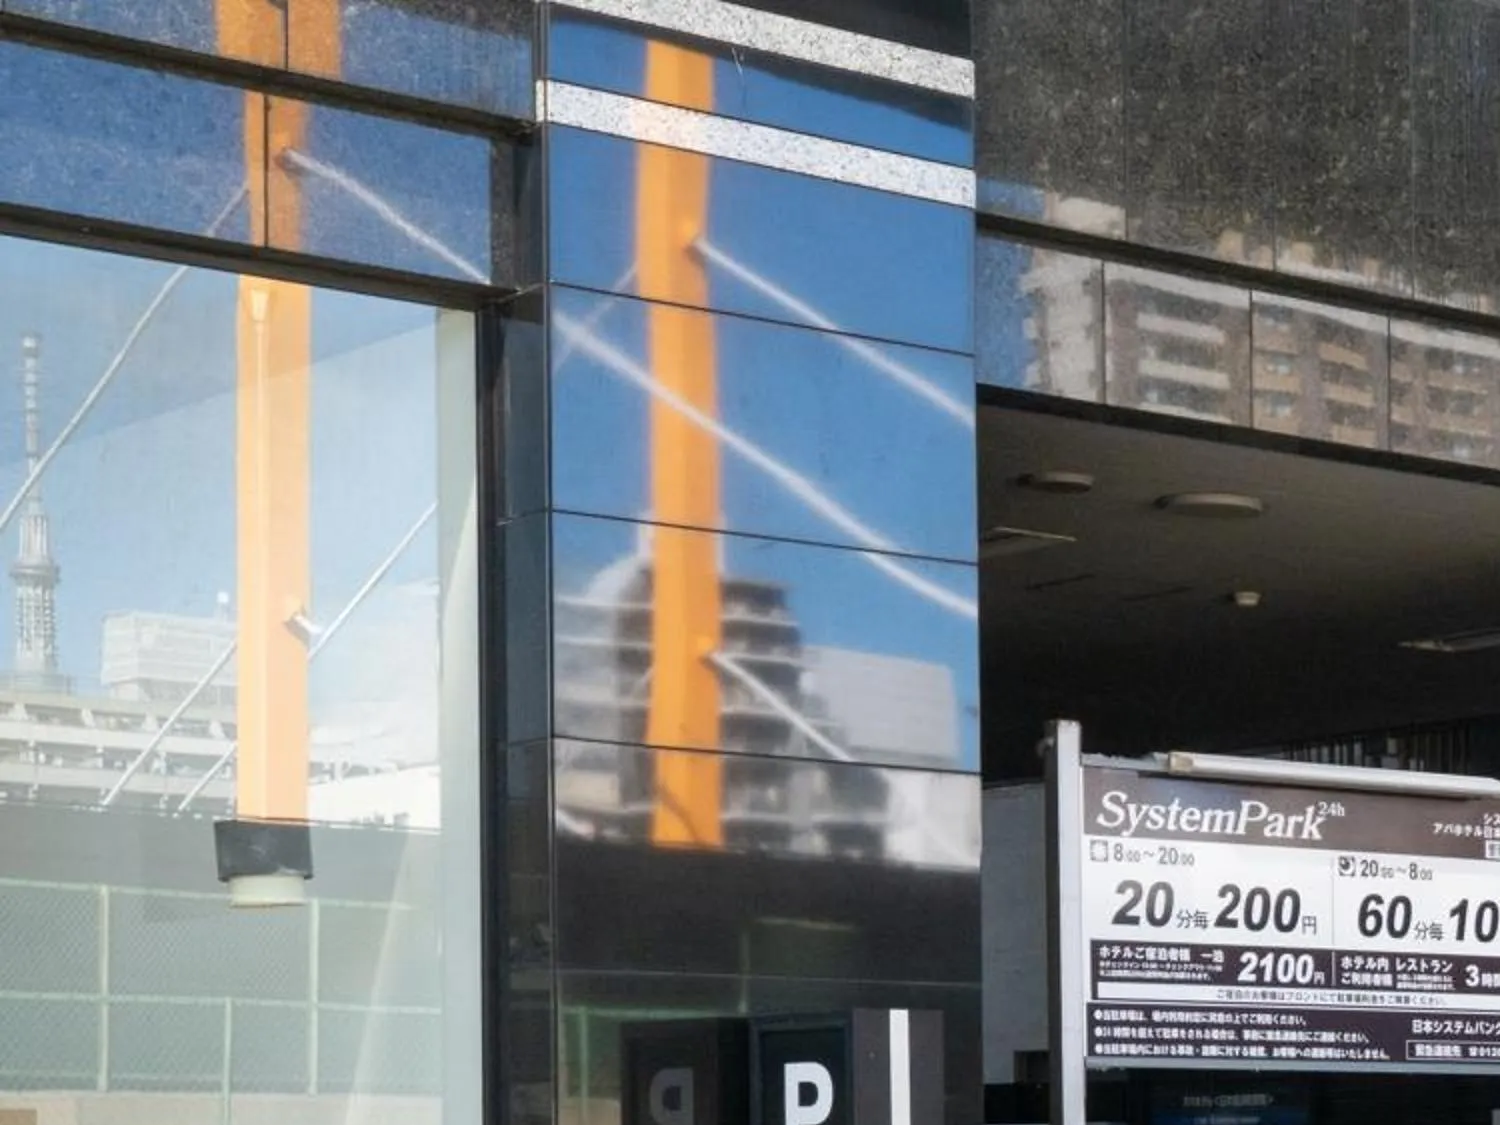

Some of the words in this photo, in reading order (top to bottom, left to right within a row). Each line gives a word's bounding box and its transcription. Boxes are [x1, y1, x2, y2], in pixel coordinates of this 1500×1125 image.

[1096, 790, 1327, 841] SystemPark
[1318, 801, 1345, 817] 24h
[1395, 957, 1453, 973] レストラン
